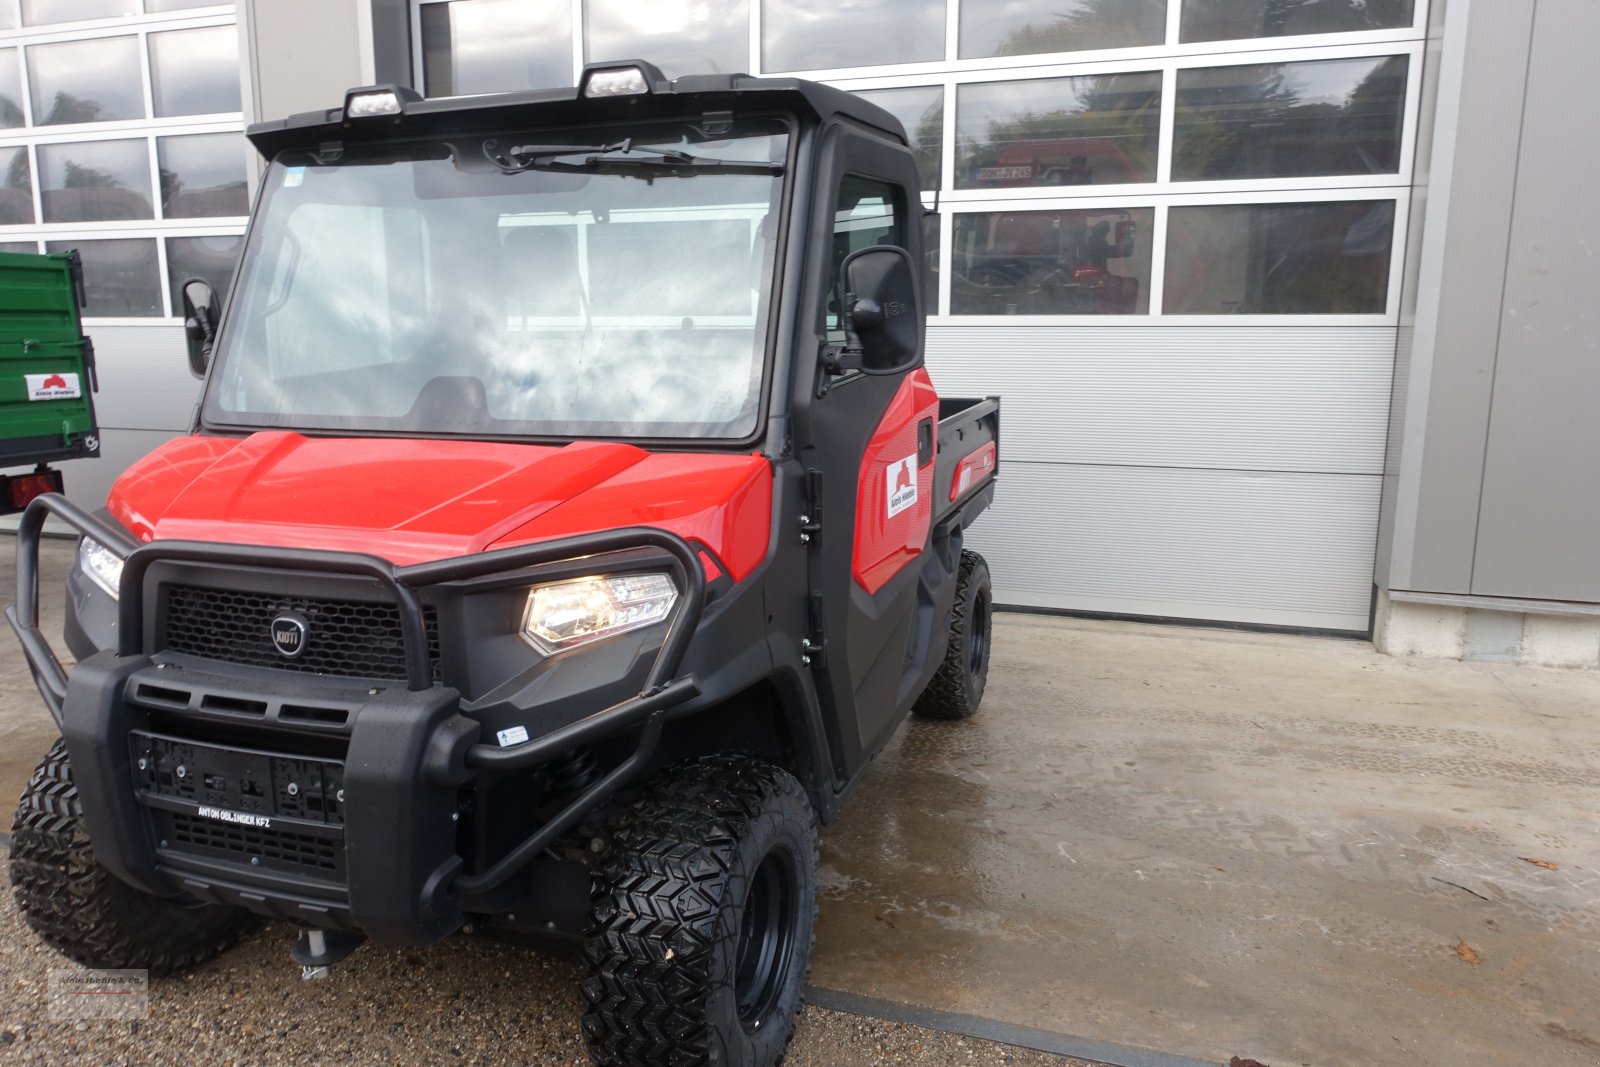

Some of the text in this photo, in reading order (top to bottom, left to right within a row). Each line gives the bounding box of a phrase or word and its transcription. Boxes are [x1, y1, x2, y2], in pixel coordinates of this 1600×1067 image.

[276, 630, 298, 645] KIOTI
[198, 805, 271, 828] ANTON OBLINGER KFZ
